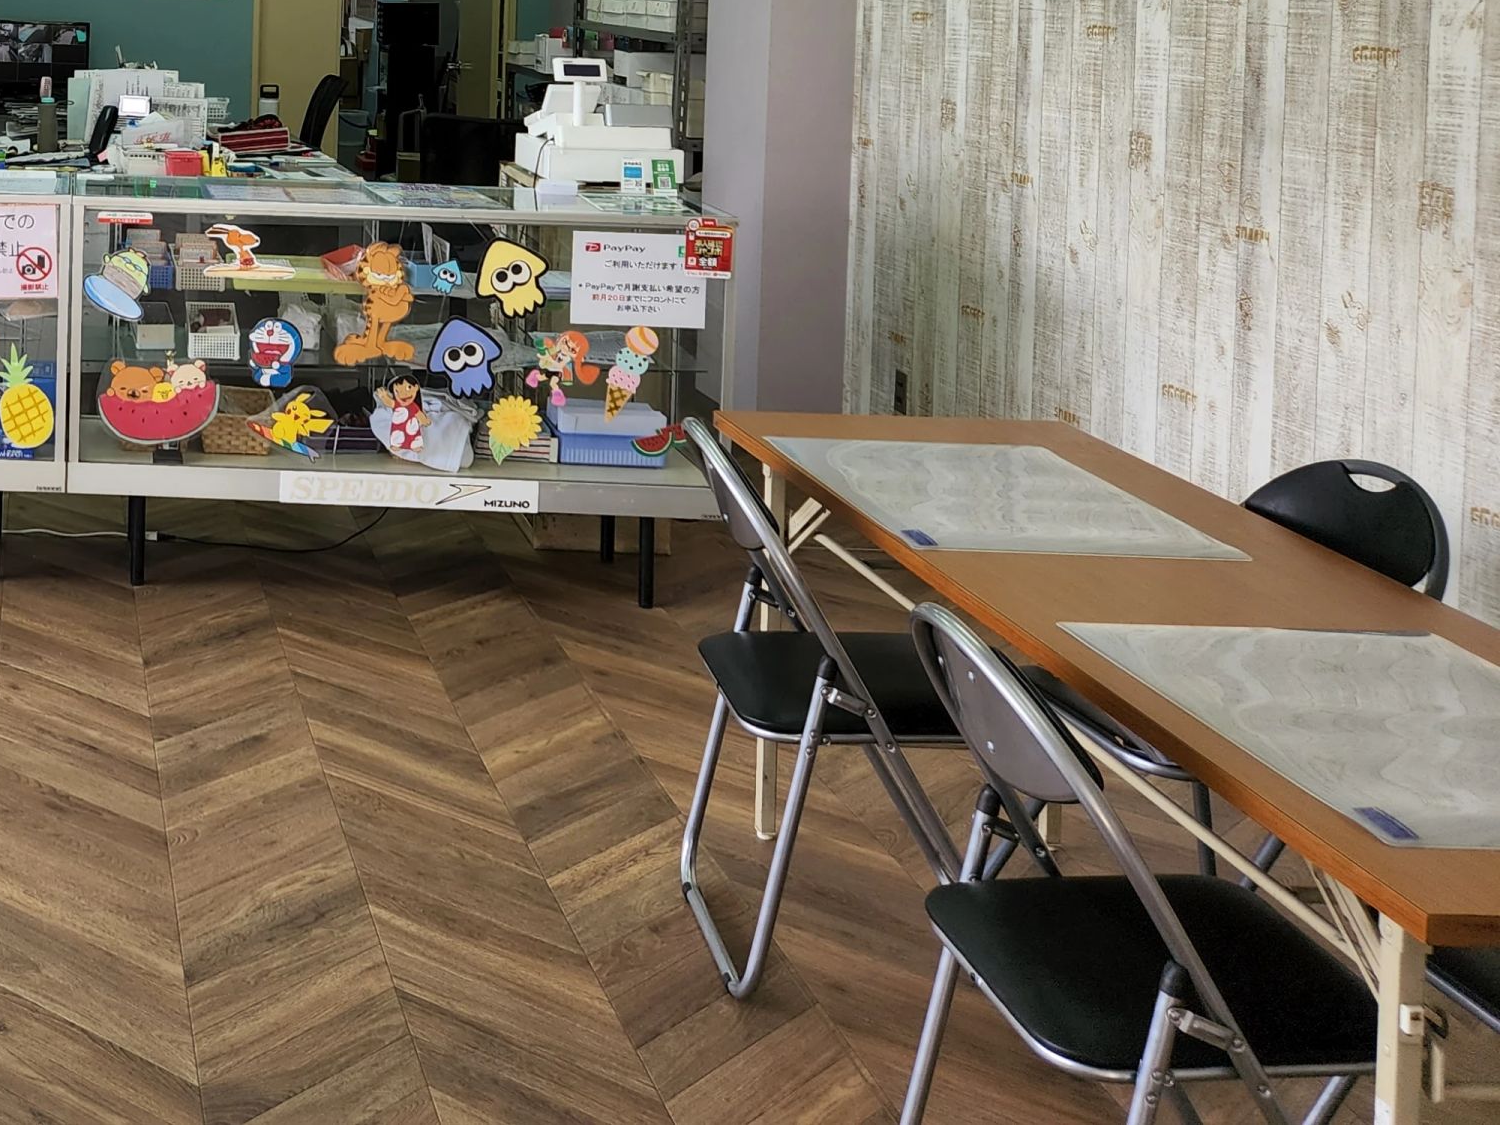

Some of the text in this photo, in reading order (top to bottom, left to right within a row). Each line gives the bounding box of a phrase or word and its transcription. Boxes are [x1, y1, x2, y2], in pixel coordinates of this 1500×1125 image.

[603, 243, 646, 254] PayPay
[290, 475, 530, 509] SPEEDO MIZUNO
